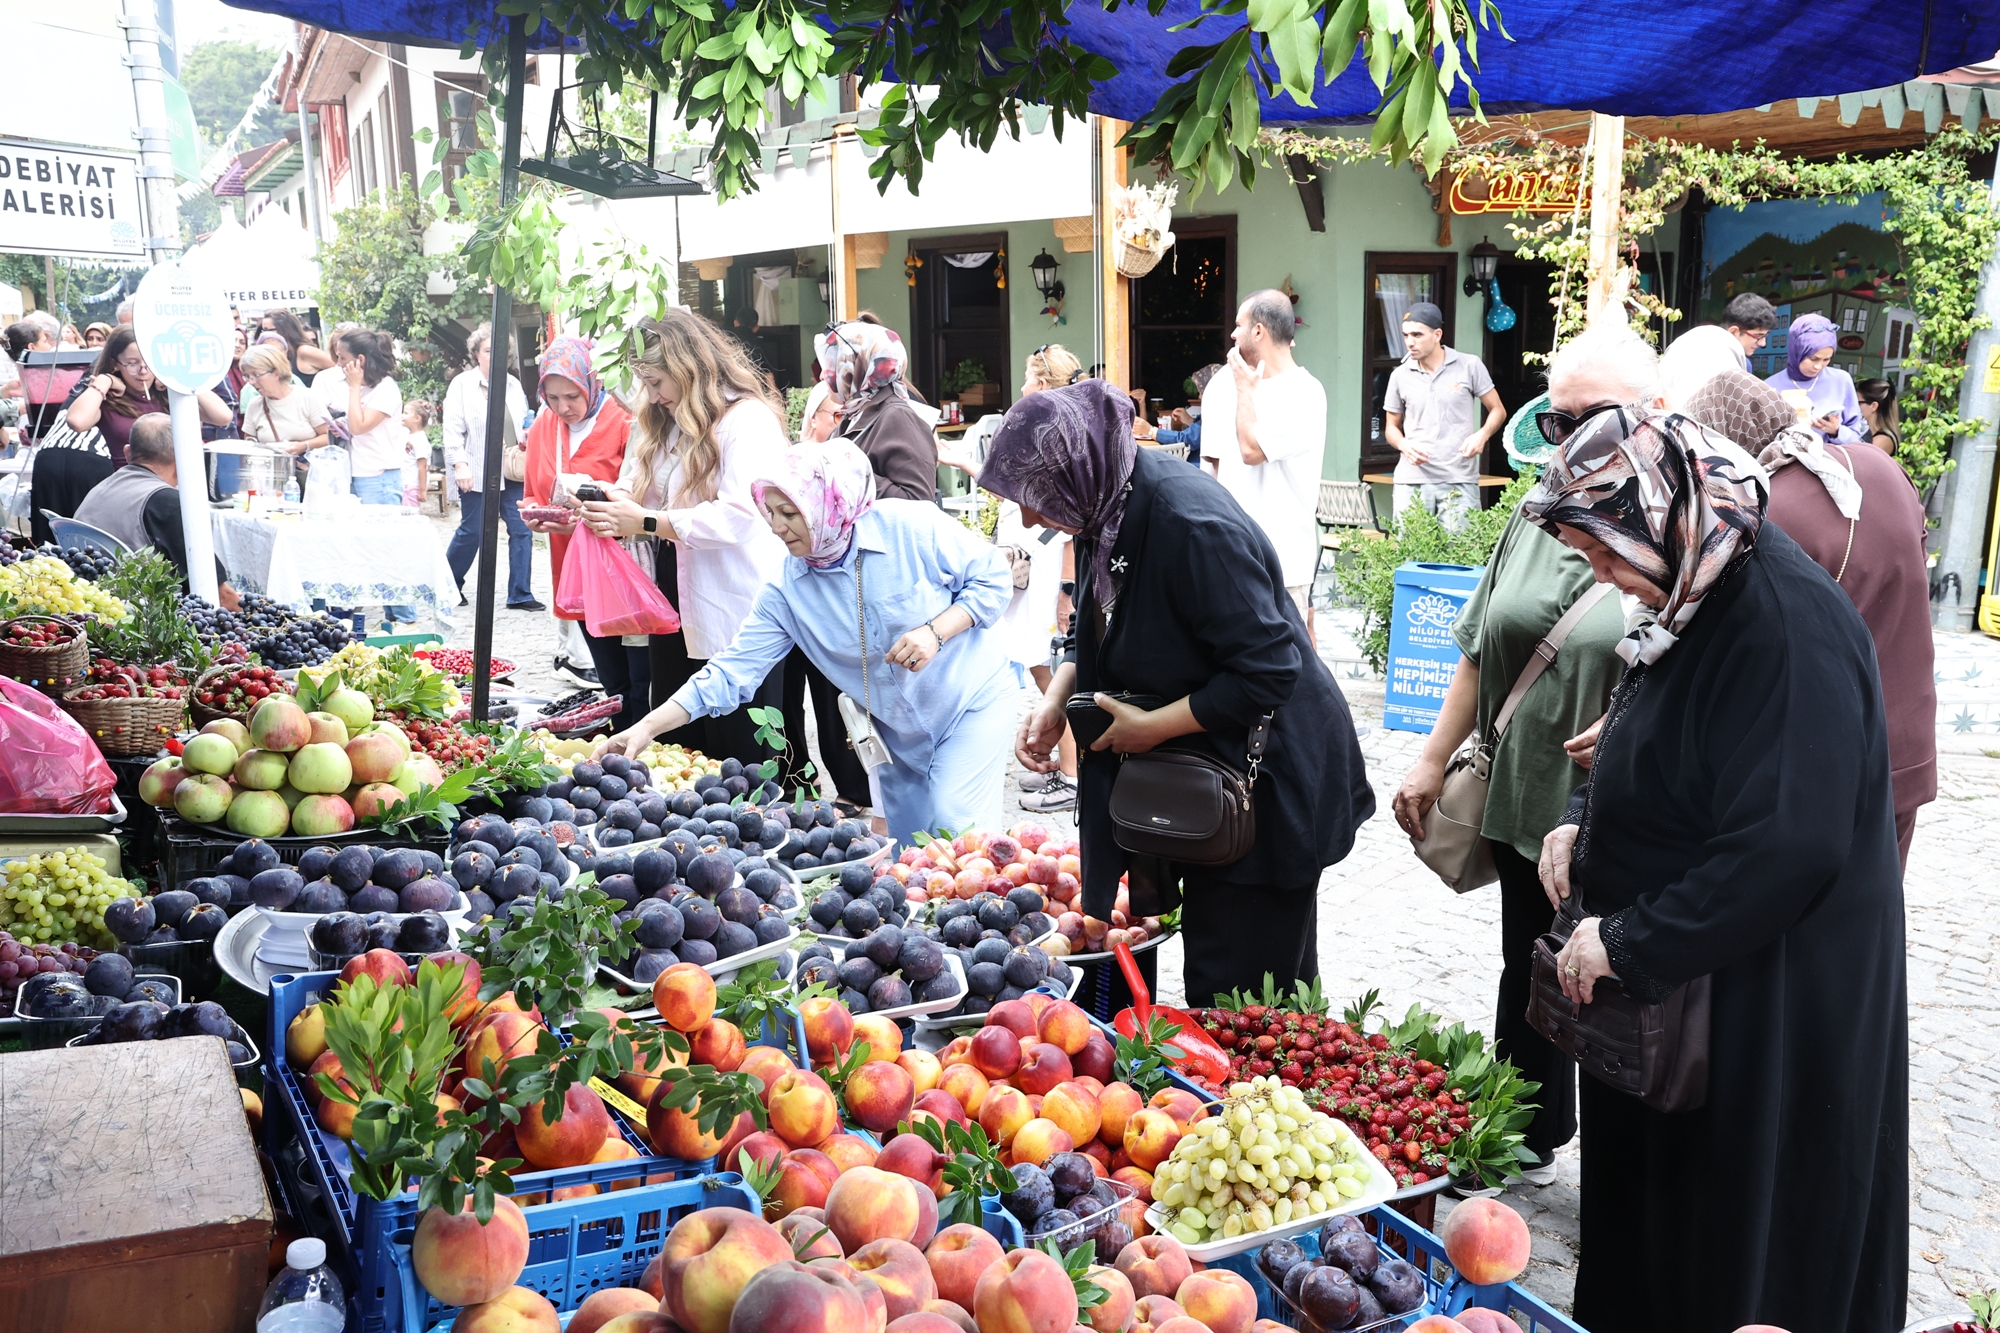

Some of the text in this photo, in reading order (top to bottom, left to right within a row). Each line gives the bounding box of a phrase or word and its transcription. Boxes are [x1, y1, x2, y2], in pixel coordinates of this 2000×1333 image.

[0, 155, 116, 189] DEBİYAT
[3, 188, 115, 220] ALERİSİ
[262, 288, 310, 300] BELED
[155, 301, 212, 316] ÜCRETSİZ
[1409, 636, 1453, 646] BELEDİYESİ
[1395, 656, 1440, 670] HERKESİN
[1392, 679, 1449, 699] NİLÜFER
